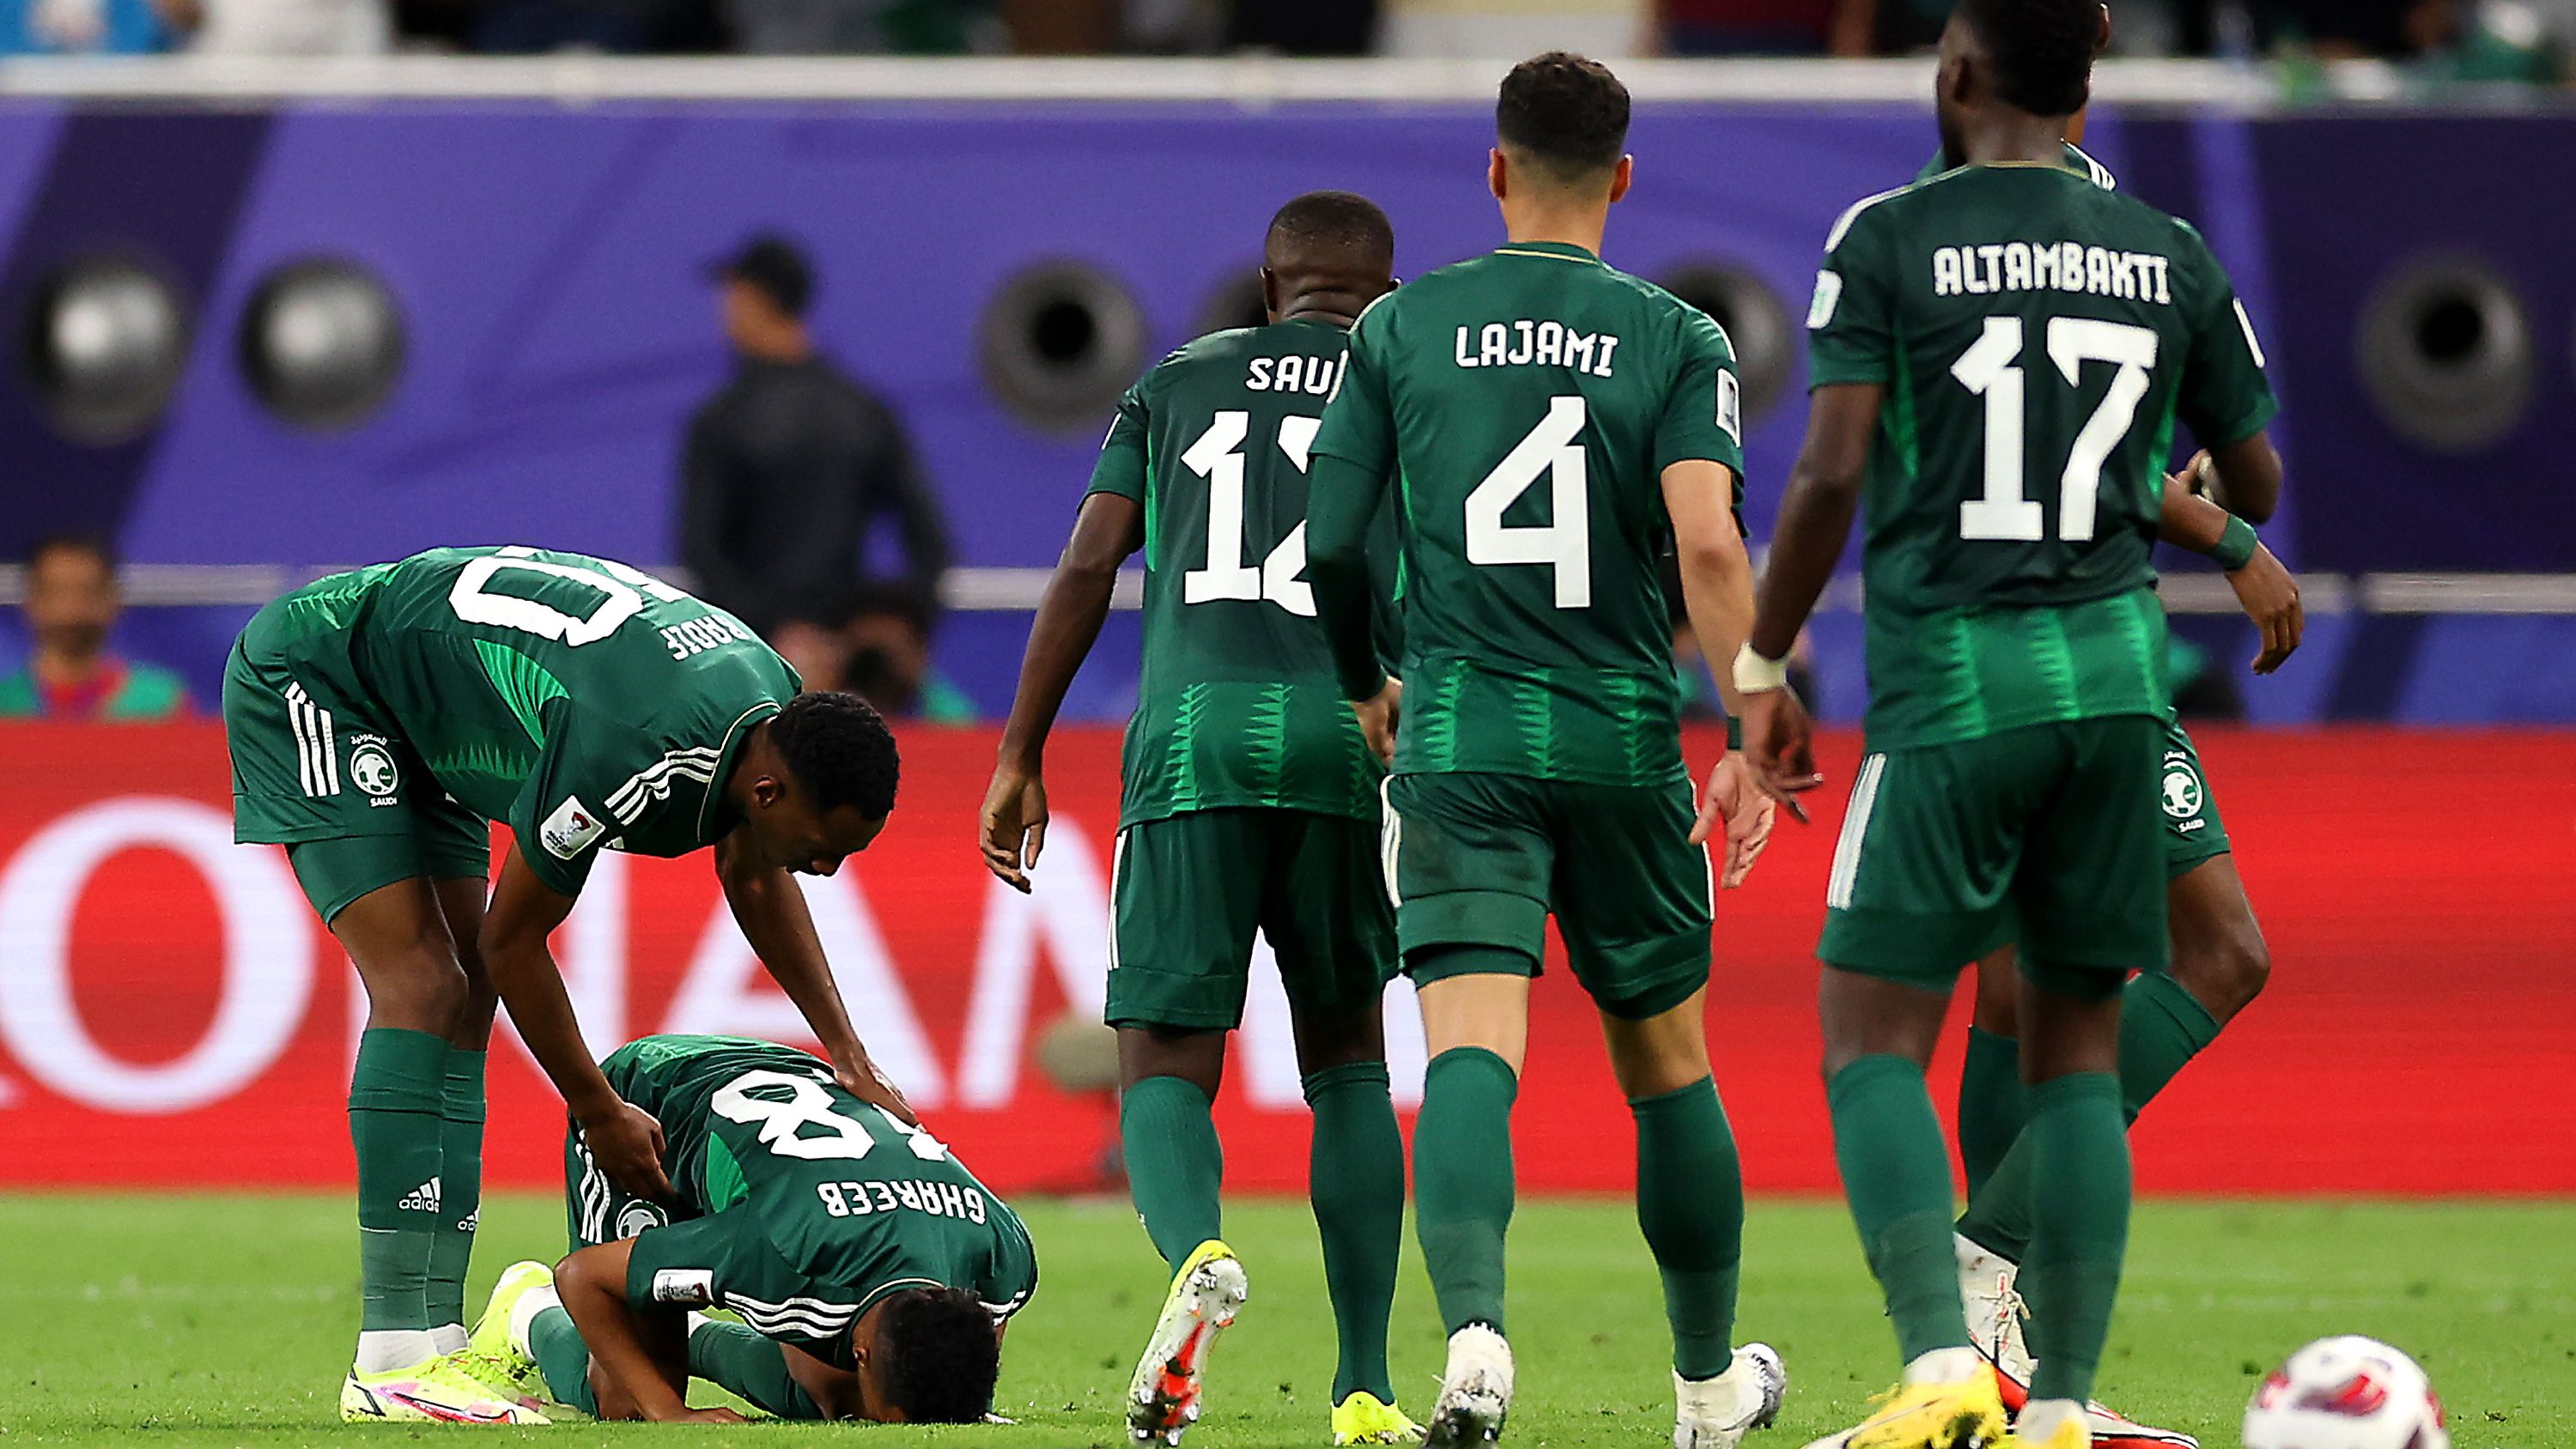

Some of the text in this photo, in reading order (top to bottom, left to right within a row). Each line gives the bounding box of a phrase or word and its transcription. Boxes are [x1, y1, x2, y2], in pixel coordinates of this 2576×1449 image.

[1933, 241, 2172, 305] ALTAMBAKTI
[1245, 355, 1334, 395] SAU
[1455, 320, 1619, 378] LAJAMI
[1950, 316, 2160, 542] 17
[1465, 396, 1591, 608] 4
[369, 796, 398, 808] SAUDI
[398, 1198, 440, 1214] adid
[817, 1179, 987, 1225] GHAREEB
